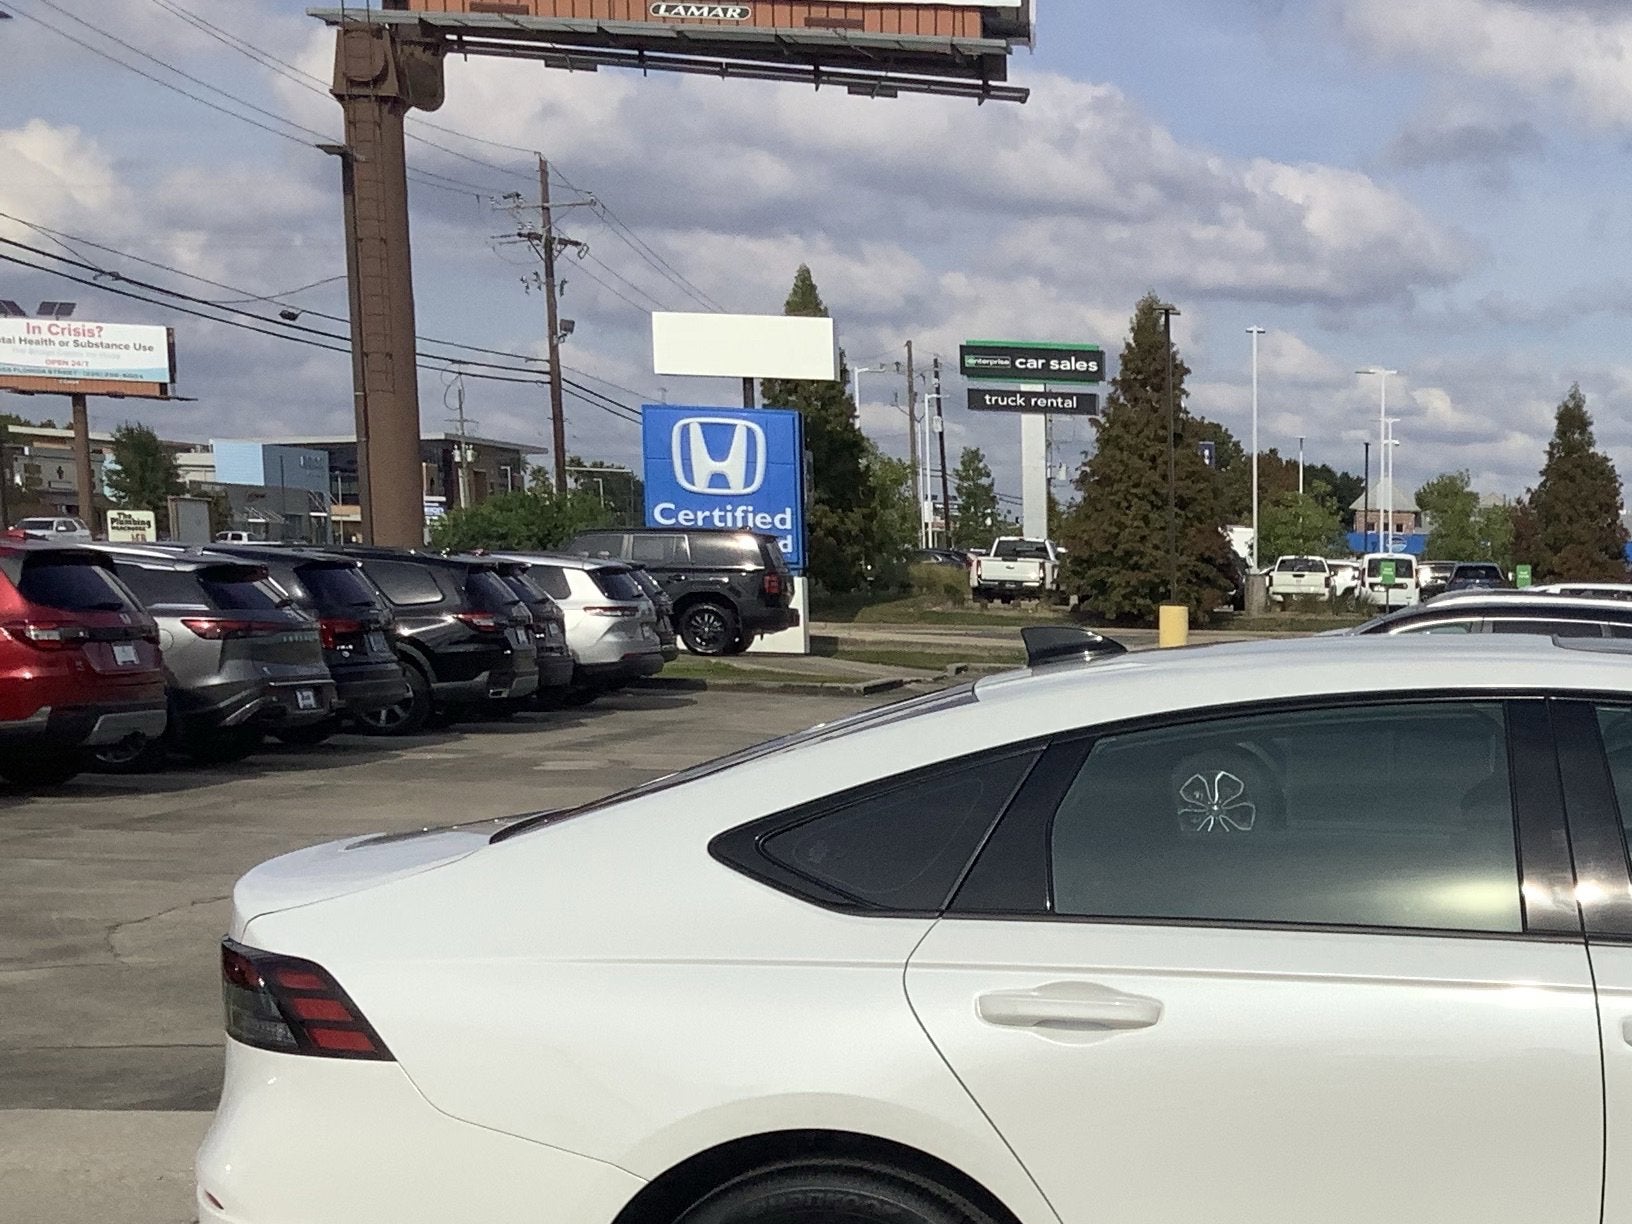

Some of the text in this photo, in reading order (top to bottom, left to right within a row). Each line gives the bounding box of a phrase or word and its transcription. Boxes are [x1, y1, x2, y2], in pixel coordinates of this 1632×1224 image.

[658, 4, 741, 18] LAMAR
[26, 322, 104, 338] In Crisis?
[18, 338, 56, 347] Health
[58, 340, 70, 348] or
[73, 339, 130, 352] Substance
[132, 342, 154, 352] Use
[1015, 358, 1046, 369] car
[1049, 356, 1099, 372] sales
[984, 393, 1077, 409] truck rental
[653, 502, 792, 530] Certified
